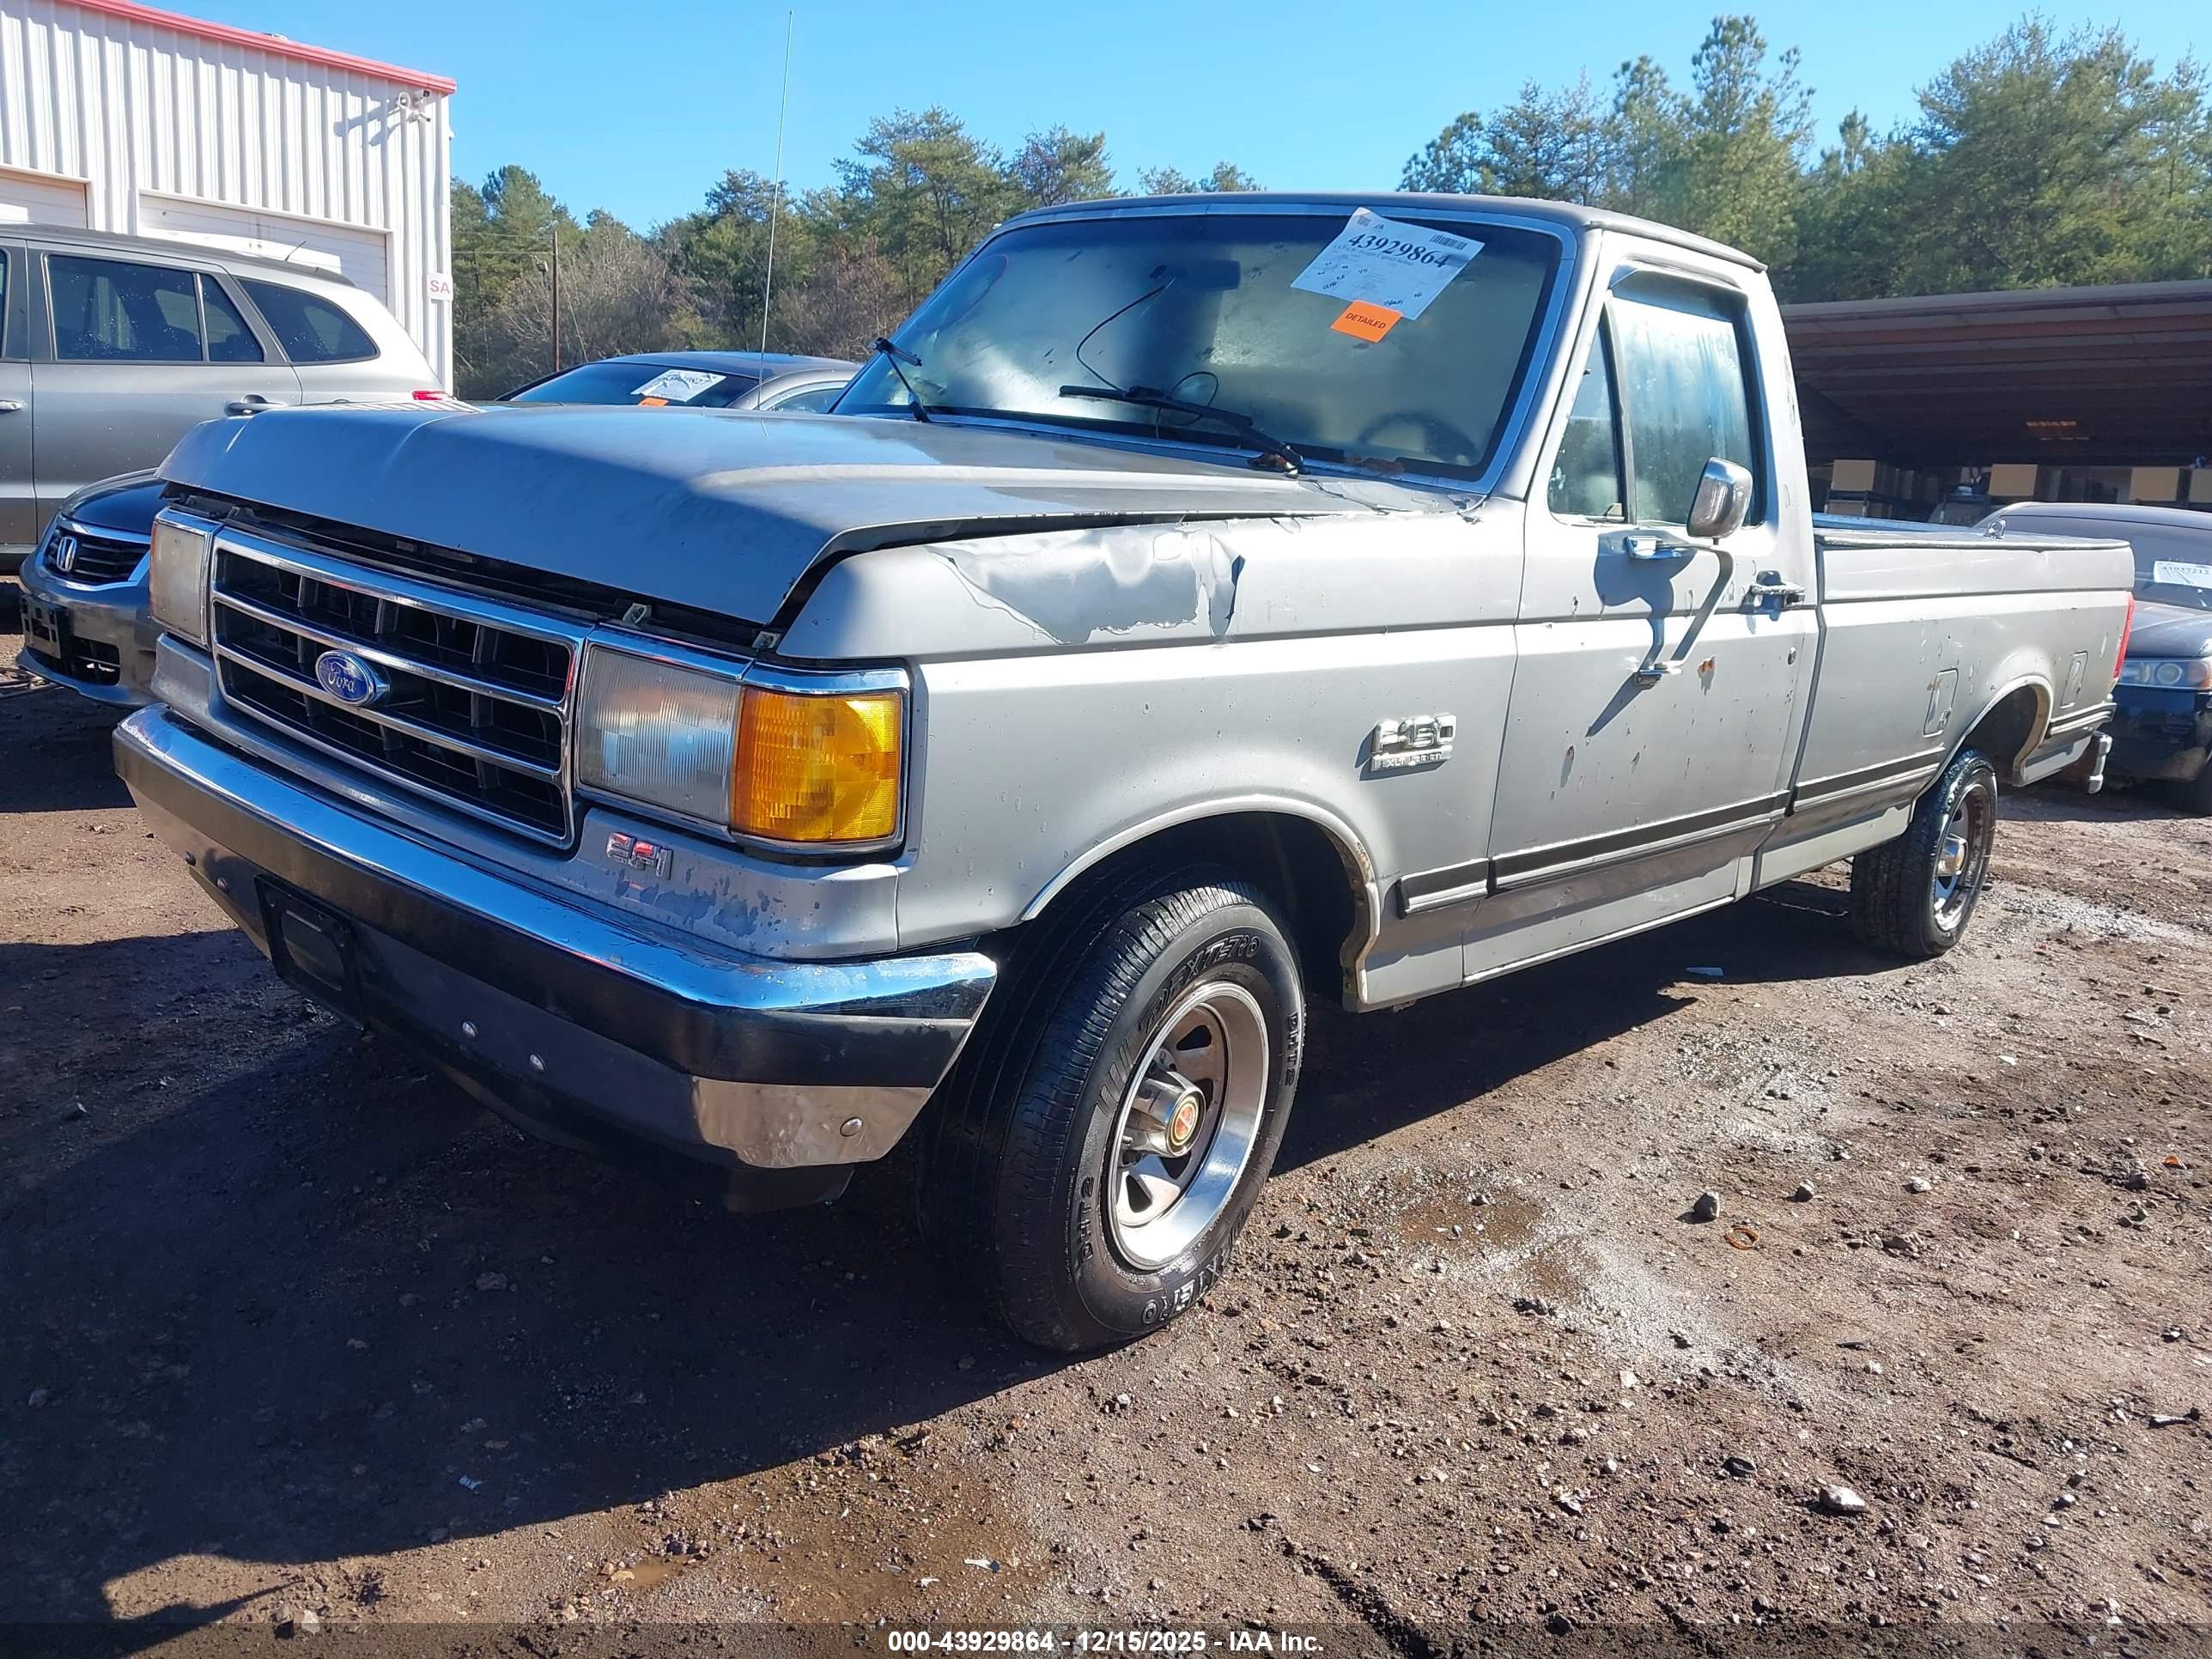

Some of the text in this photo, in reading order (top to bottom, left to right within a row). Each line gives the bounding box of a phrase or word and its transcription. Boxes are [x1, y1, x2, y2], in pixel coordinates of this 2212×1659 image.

[1348, 233, 1449, 268] 43929864
[430, 280, 450, 294] SA
[1346, 312, 1386, 330] DETAILED
[328, 660, 356, 693] Ford
